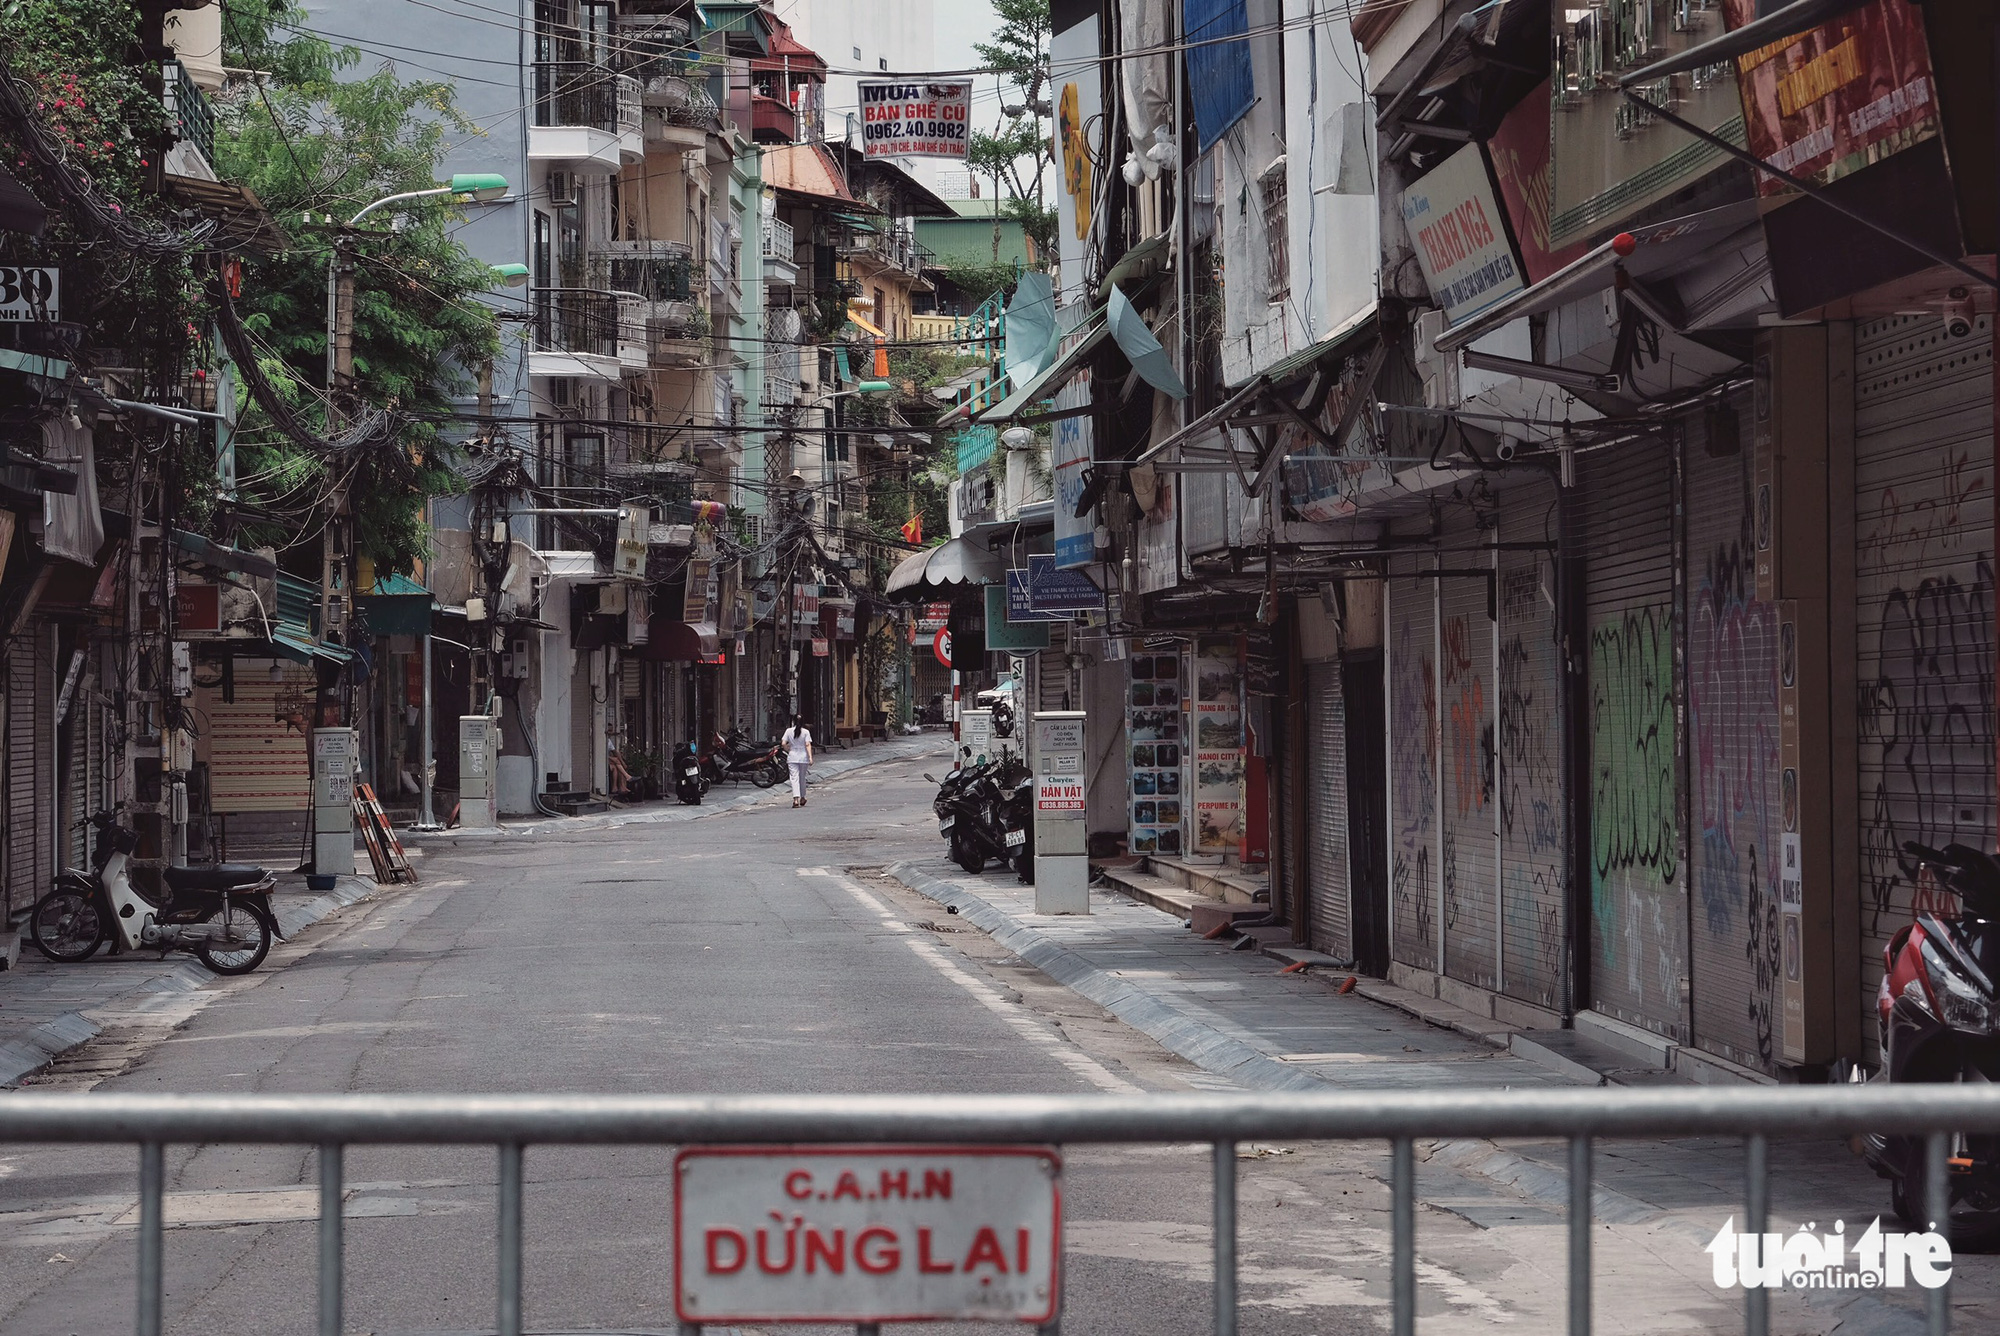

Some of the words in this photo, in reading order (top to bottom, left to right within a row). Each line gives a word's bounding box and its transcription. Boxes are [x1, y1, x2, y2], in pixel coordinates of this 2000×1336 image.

[864, 85, 920, 102] MUA
[865, 103, 900, 122] BÀN
[905, 100, 937, 119] GHẾ
[942, 103, 965, 121] CŨ
[865, 120, 965, 140] 0962.40.9982
[1418, 211, 1467, 276] THANH
[1455, 194, 1495, 255] NGA
[1198, 753, 1219, 761] HANOI
[1041, 785, 1061, 797] HÀN
[1064, 784, 1082, 799] VẶT
[785, 1169, 954, 1201] C.A.H.N
[705, 1211, 901, 1276] DỪNG
[918, 1226, 1030, 1286] LẠI
